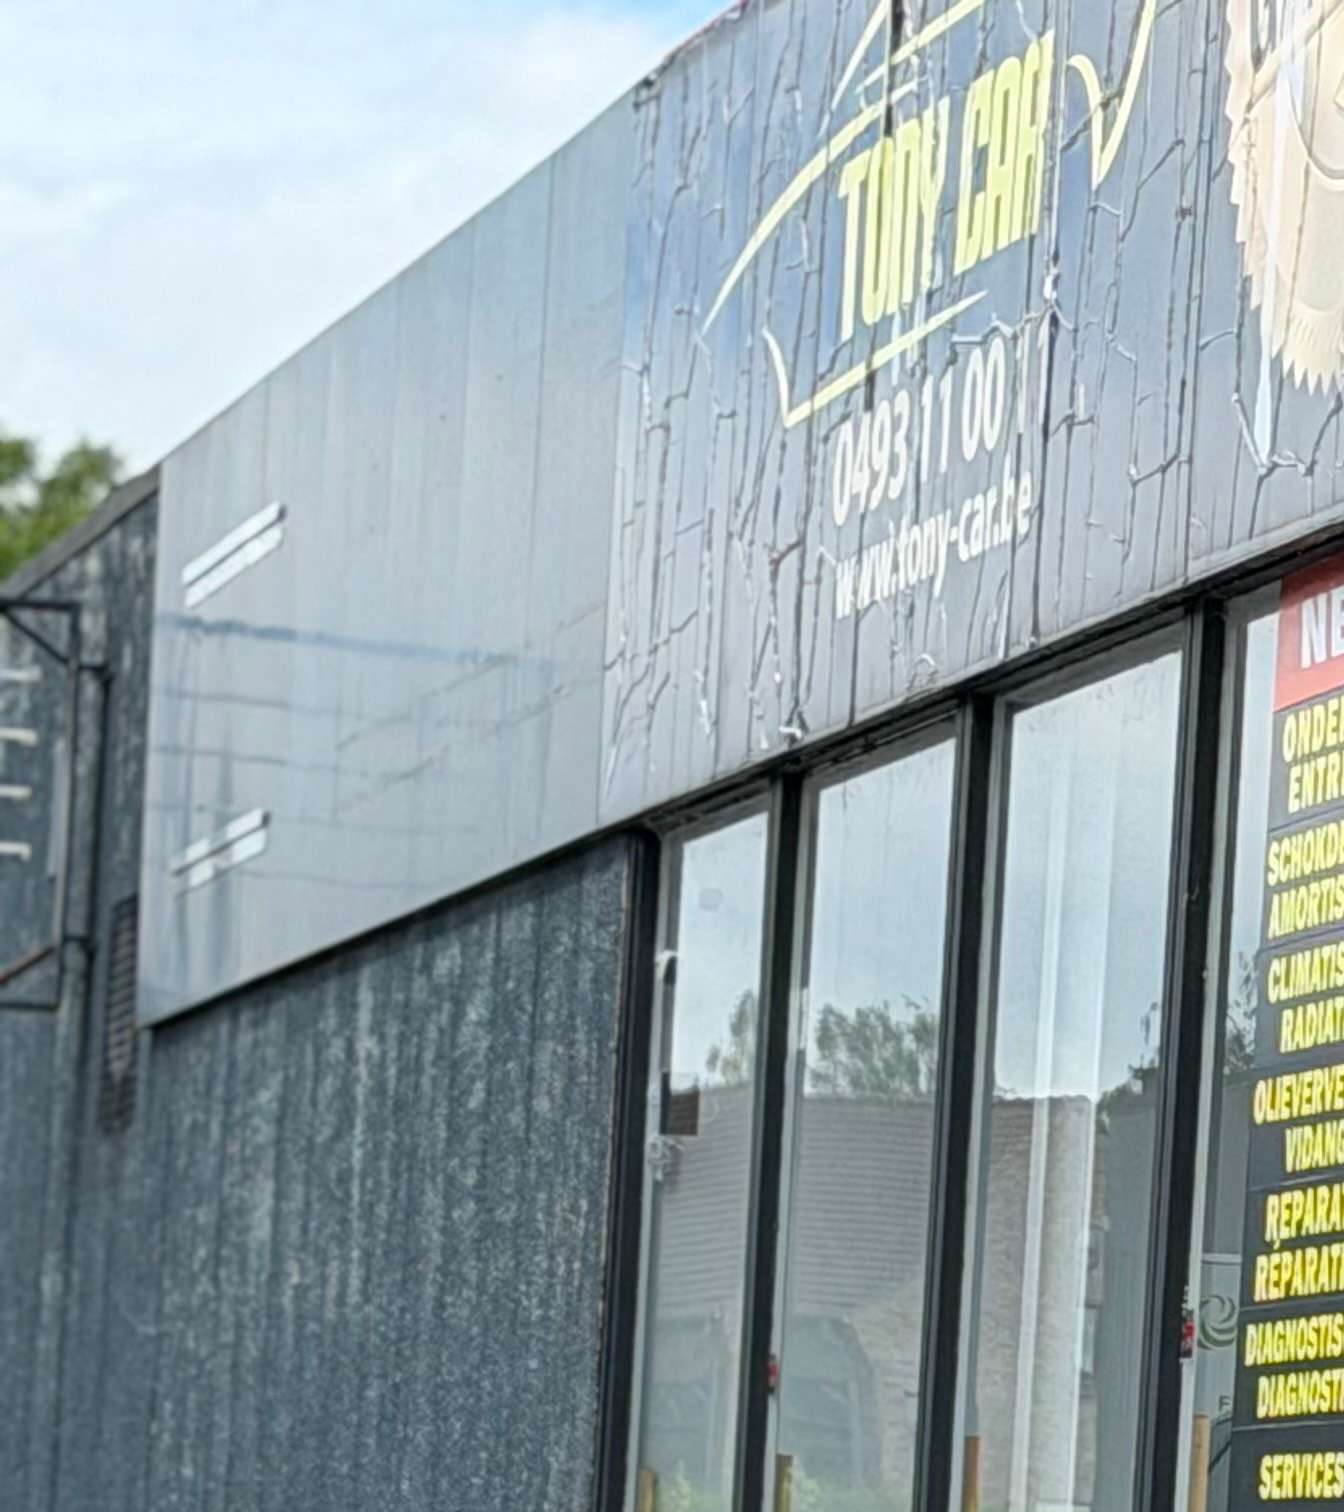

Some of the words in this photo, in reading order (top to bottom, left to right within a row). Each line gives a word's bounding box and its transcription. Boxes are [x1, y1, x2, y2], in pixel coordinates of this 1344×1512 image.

[838, 95, 950, 343] TONY
[954, 29, 1054, 276] CAR
[833, 390, 910, 526] 0493
[921, 365, 953, 482] 11
[961, 337, 1006, 462] 00
